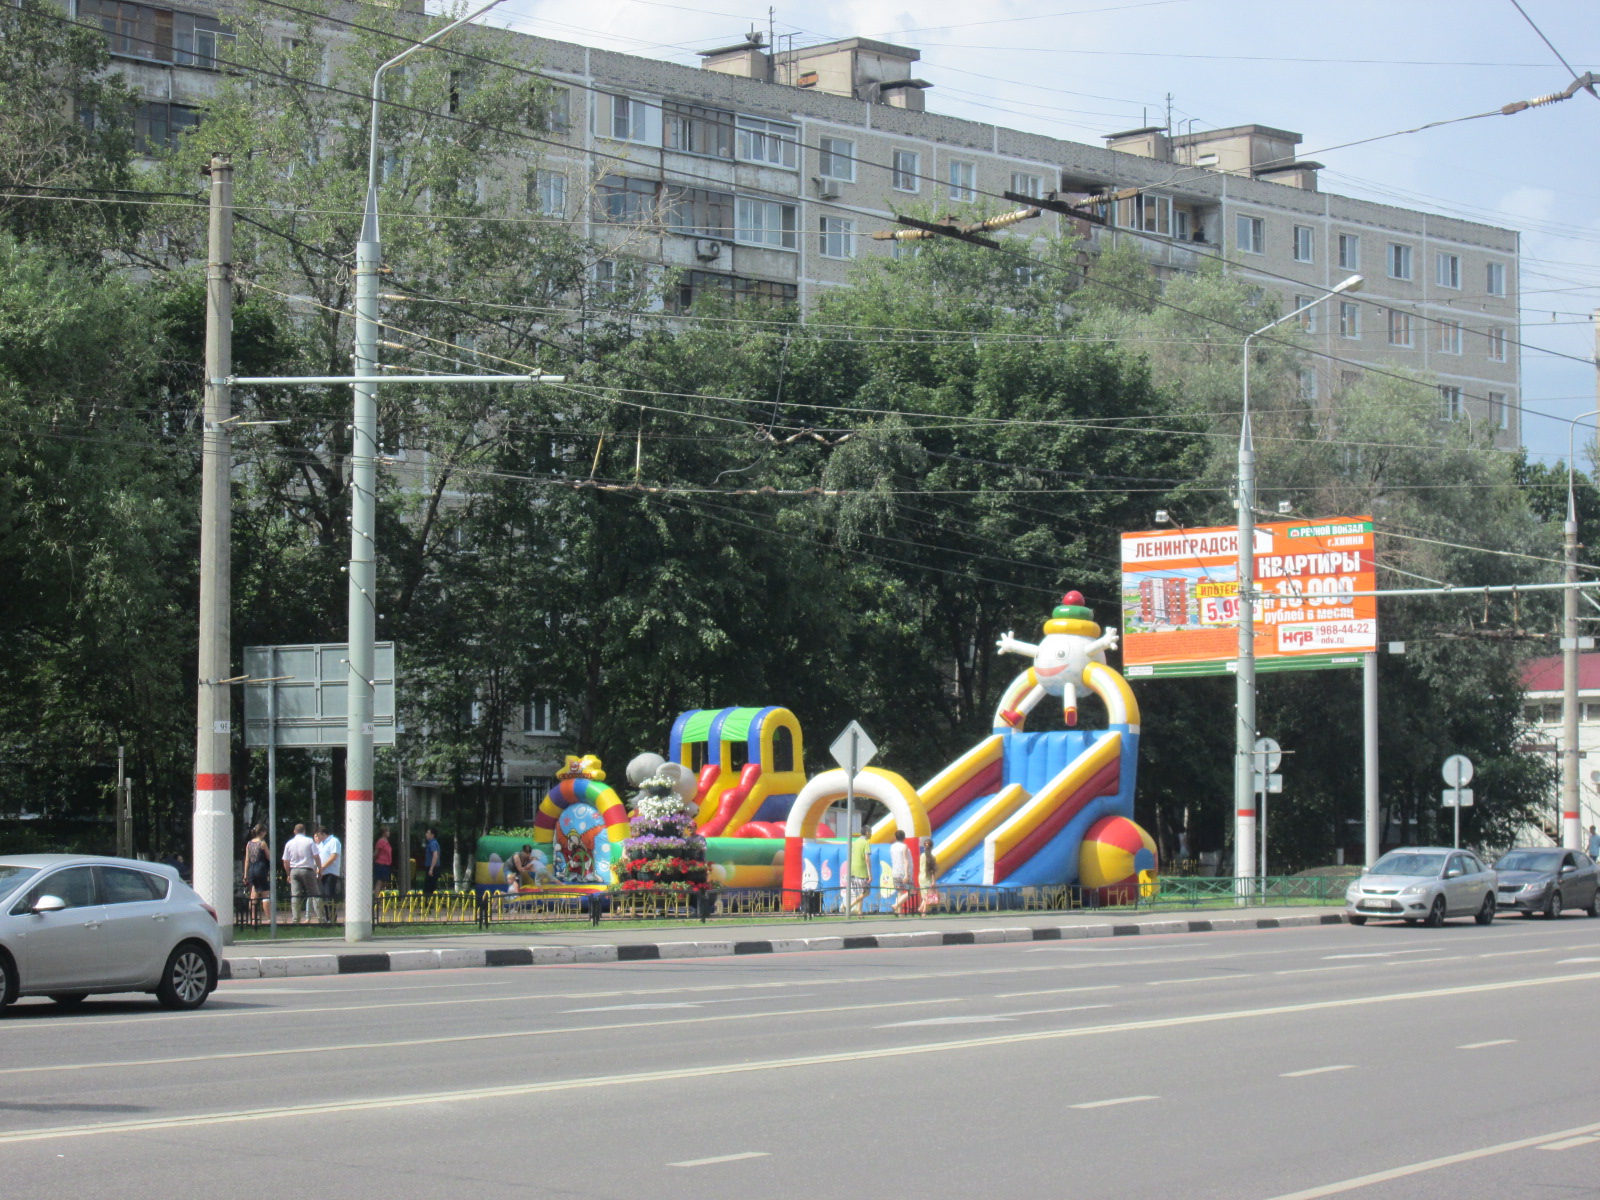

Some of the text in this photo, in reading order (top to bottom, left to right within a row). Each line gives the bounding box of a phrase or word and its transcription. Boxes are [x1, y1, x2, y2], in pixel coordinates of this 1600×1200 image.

[1301, 525, 1330, 537] РЕЧНОЙ
[1332, 523, 1363, 535] ВОКЗАЛ
[1135, 534, 1257, 558] ЛЕНИНГРАДСК
[1327, 536, 1364, 547] г.ХИМКИ
[1258, 551, 1360, 577] КВАРТИРЫ
[1200, 585, 1238, 596] ИПОТЕК
[1264, 598, 1274, 609] от
[1264, 607, 1354, 625] рублей в месяц
[1320, 623, 1370, 636] 988-44-22
[1321, 636, 1344, 645] ndv.ru
[220, 722, 228, 732] 95
